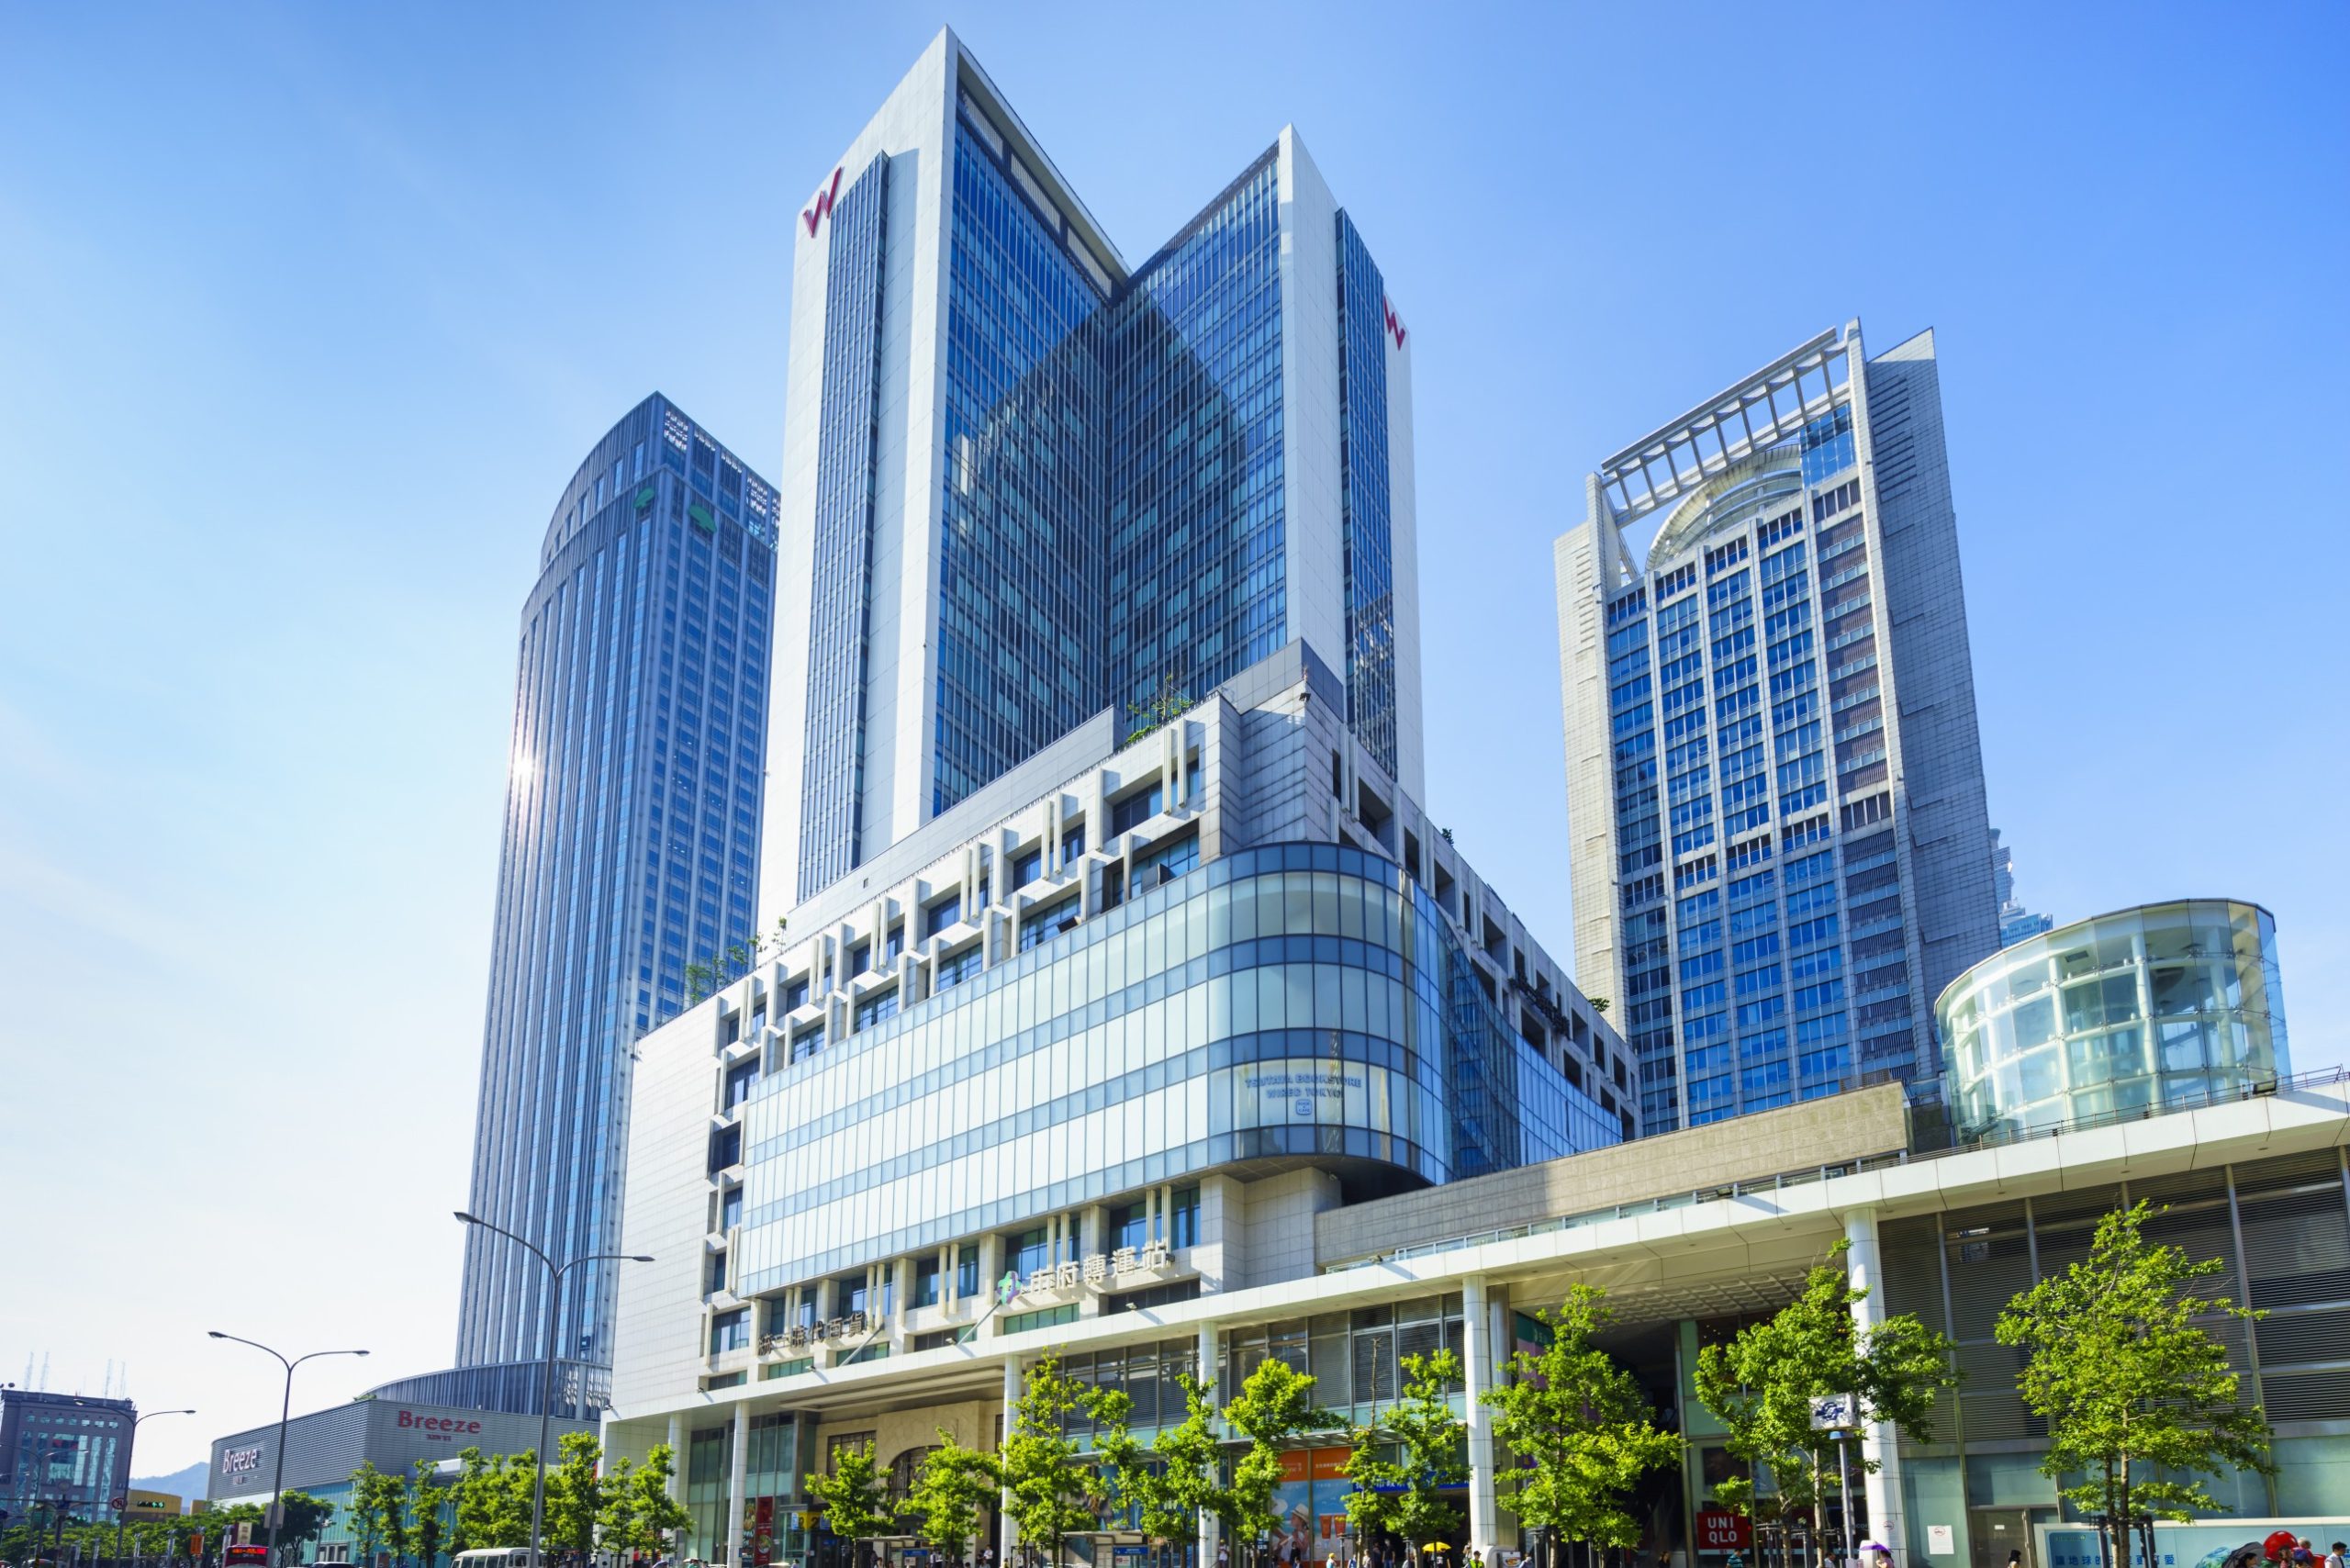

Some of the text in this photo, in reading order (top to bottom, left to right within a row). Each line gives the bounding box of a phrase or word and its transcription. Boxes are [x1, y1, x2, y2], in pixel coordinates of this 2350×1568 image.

[1030, 1239, 1167, 1296] 市府轉運站
[397, 1410, 482, 1434] Breeze
[222, 1449, 258, 1474] Breeze
[1707, 1517, 1734, 1529] UNI
[1708, 1530, 1738, 1545] QLO
